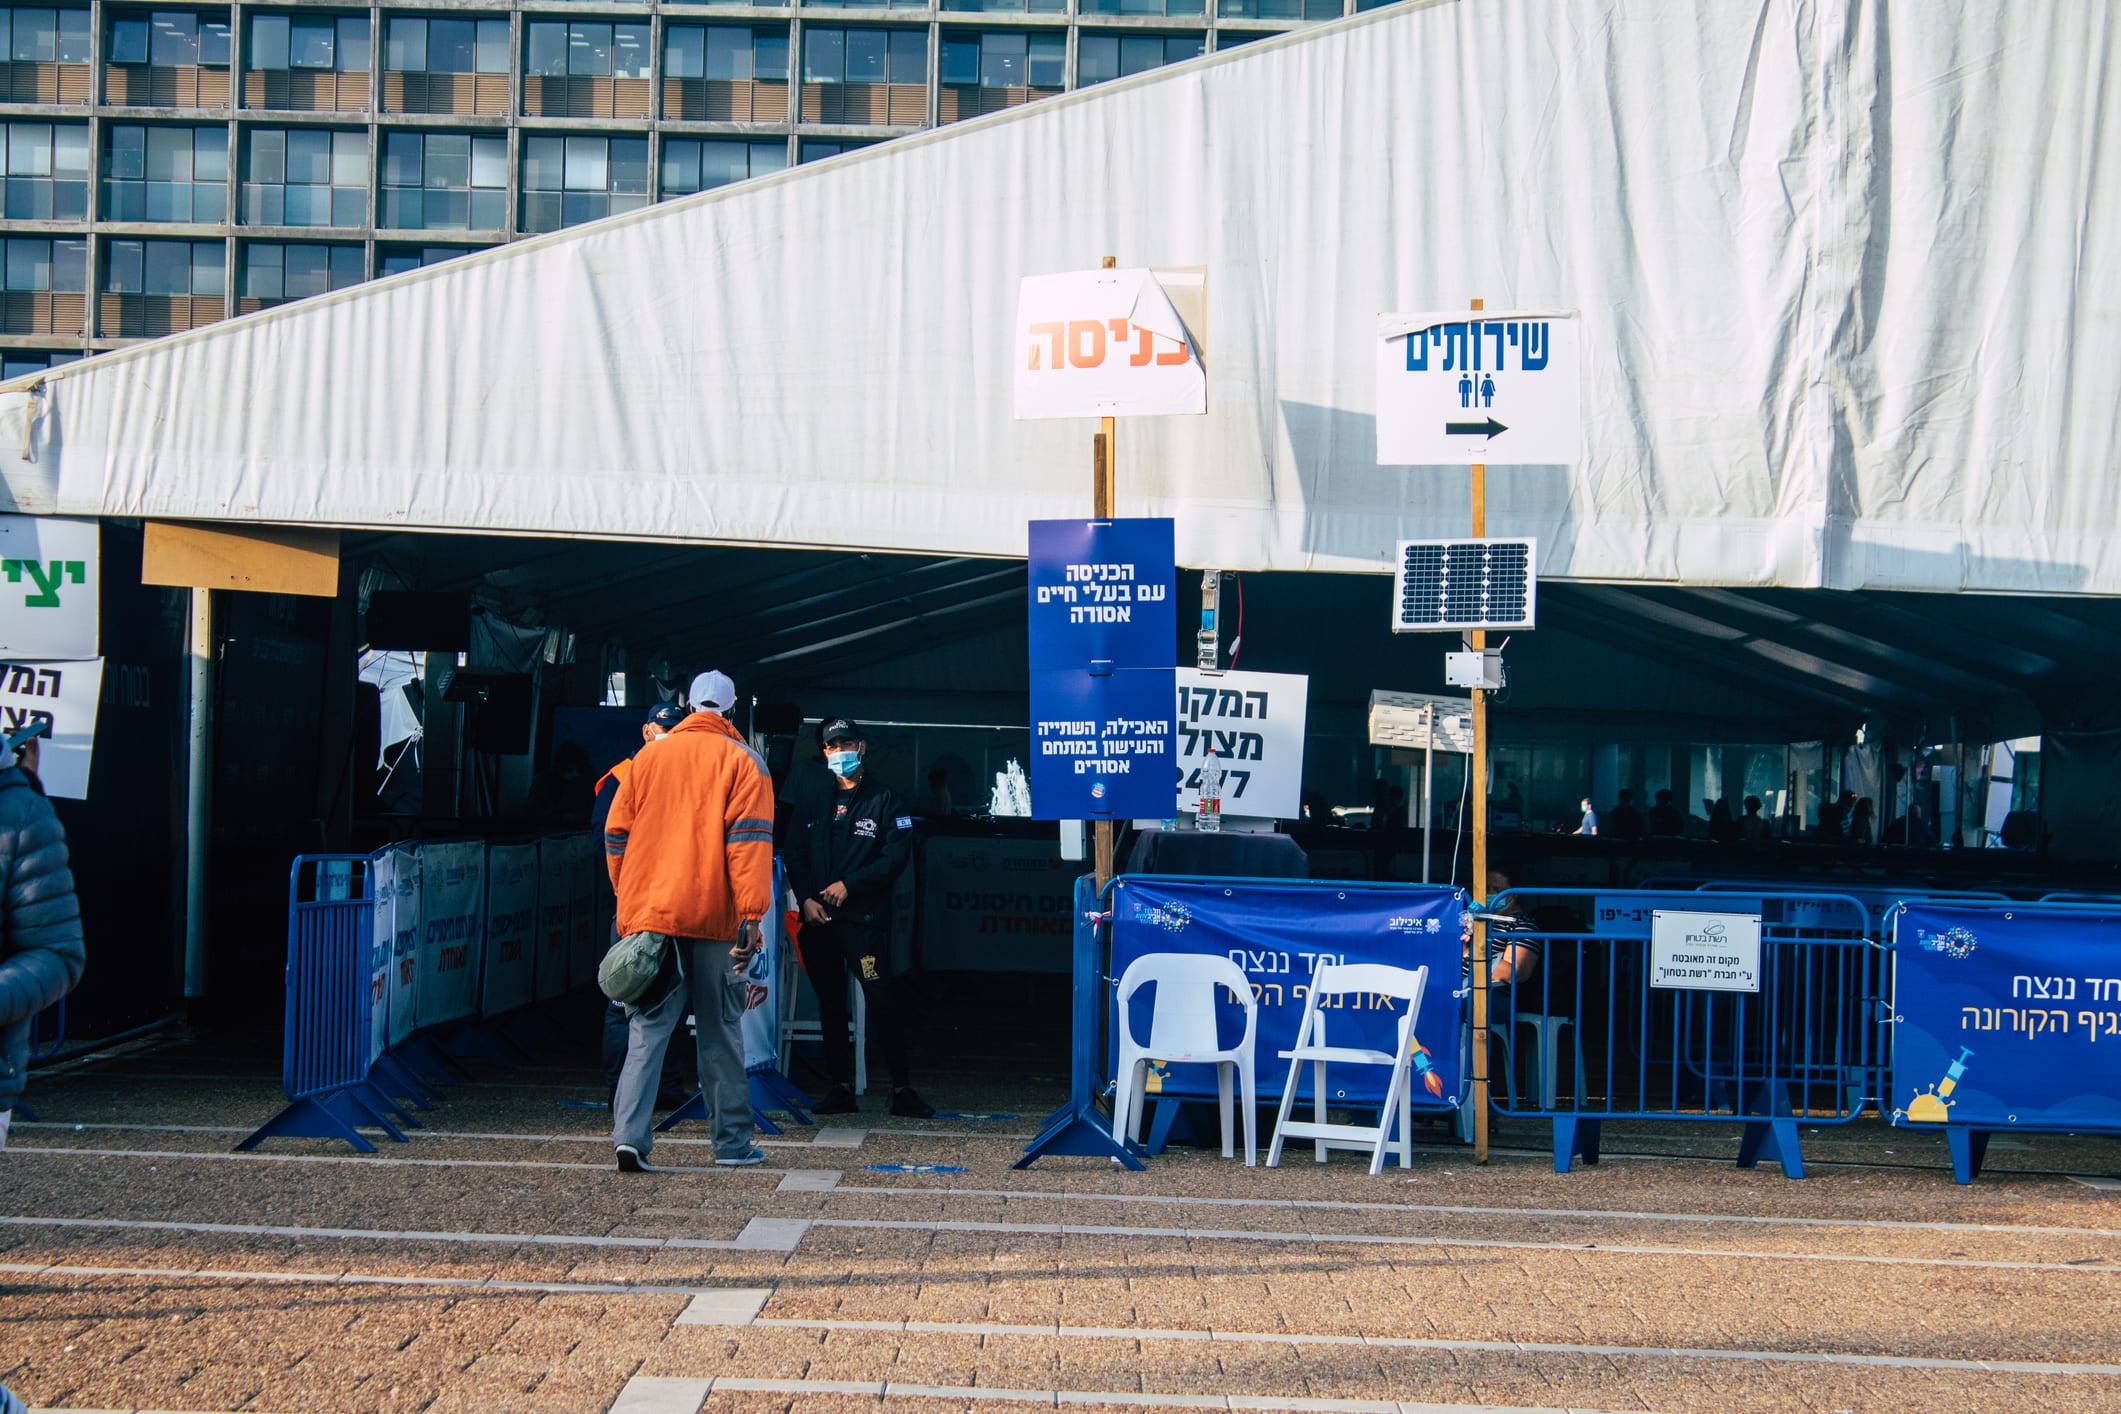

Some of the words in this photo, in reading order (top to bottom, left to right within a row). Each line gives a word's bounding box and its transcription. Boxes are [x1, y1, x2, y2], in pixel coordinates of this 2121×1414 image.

[1406, 322, 1549, 371] שירותים
[1066, 564, 1135, 582] הכניסה
[1037, 585, 1078, 603] חיים
[1082, 581, 1132, 602] בעלי
[1137, 584, 1165, 602] עם
[1070, 606, 1131, 624] אסורה
[1038, 720, 1096, 736] השתייה
[1101, 718, 1168, 738] האכילה,
[1042, 740, 1098, 755] במתחם
[1102, 740, 1165, 757] והעישון
[1074, 759, 1130, 774] אסורים
[1389, 916, 1423, 927] איכילוב
[1686, 934, 1707, 944] בטחון
[1709, 935, 1728, 943] רשת
[1672, 954, 1705, 964] מאובטח
[1706, 955, 1716, 964] זה
[1718, 956, 1740, 967] מקום
[1713, 970, 1736, 979] חברת
[1739, 970, 1752, 980] ע"י
[2012, 975, 2076, 1000] ננצח
[2084, 978, 2121, 1002] חד
[1962, 1007, 2069, 1041] הקורונה
